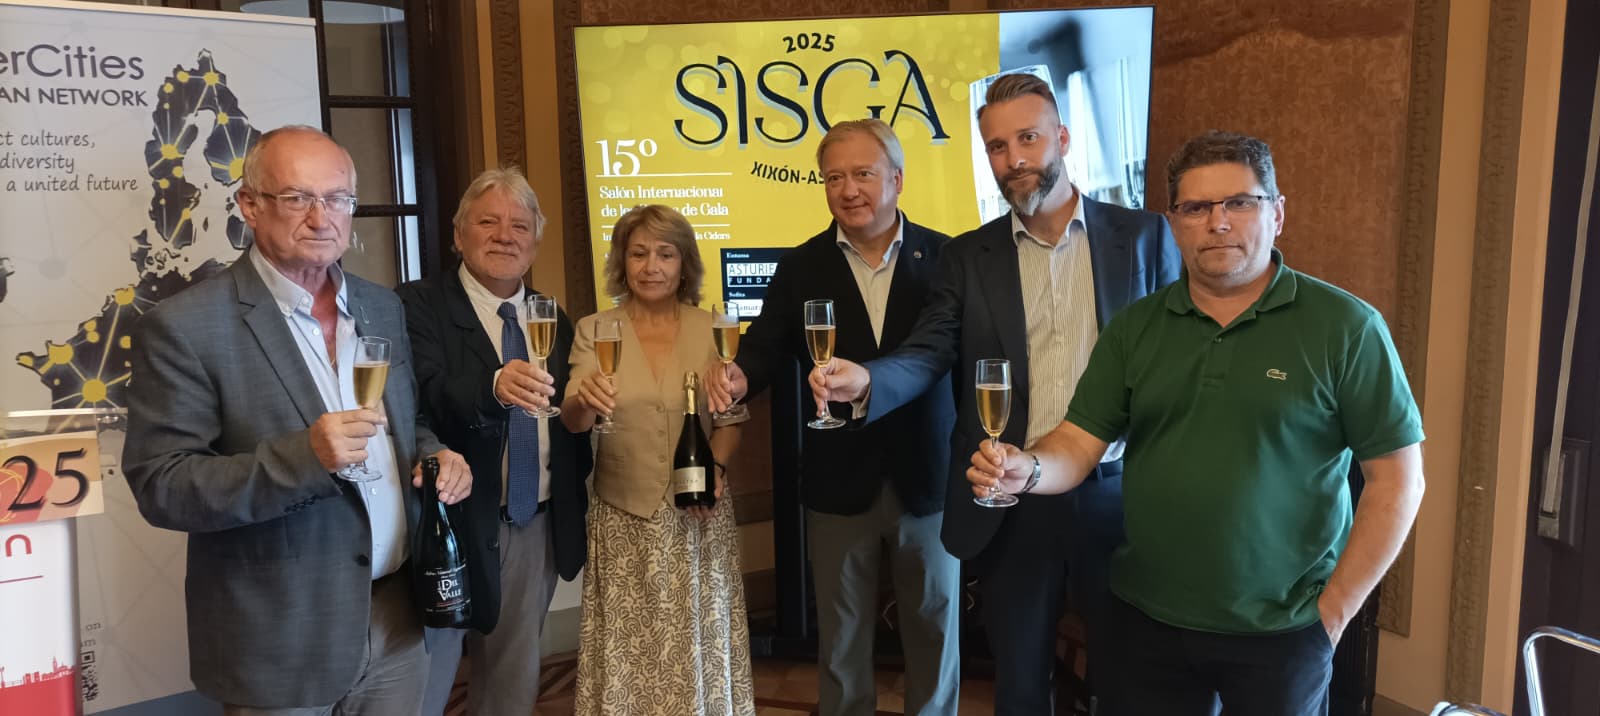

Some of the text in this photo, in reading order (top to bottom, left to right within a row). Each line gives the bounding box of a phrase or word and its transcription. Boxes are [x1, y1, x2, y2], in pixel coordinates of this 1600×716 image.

[783, 32, 835, 53] 2025
[38, 87, 148, 106] NETWORK
[674, 50, 950, 148] SISGA
[0, 129, 95, 148] t cultures,
[6, 174, 138, 192] a united future
[599, 185, 724, 199] Salón Internacional
[601, 204, 618, 217] de
[681, 203, 698, 216] de
[700, 202, 729, 216] Gala
[1, 448, 89, 512] 25
